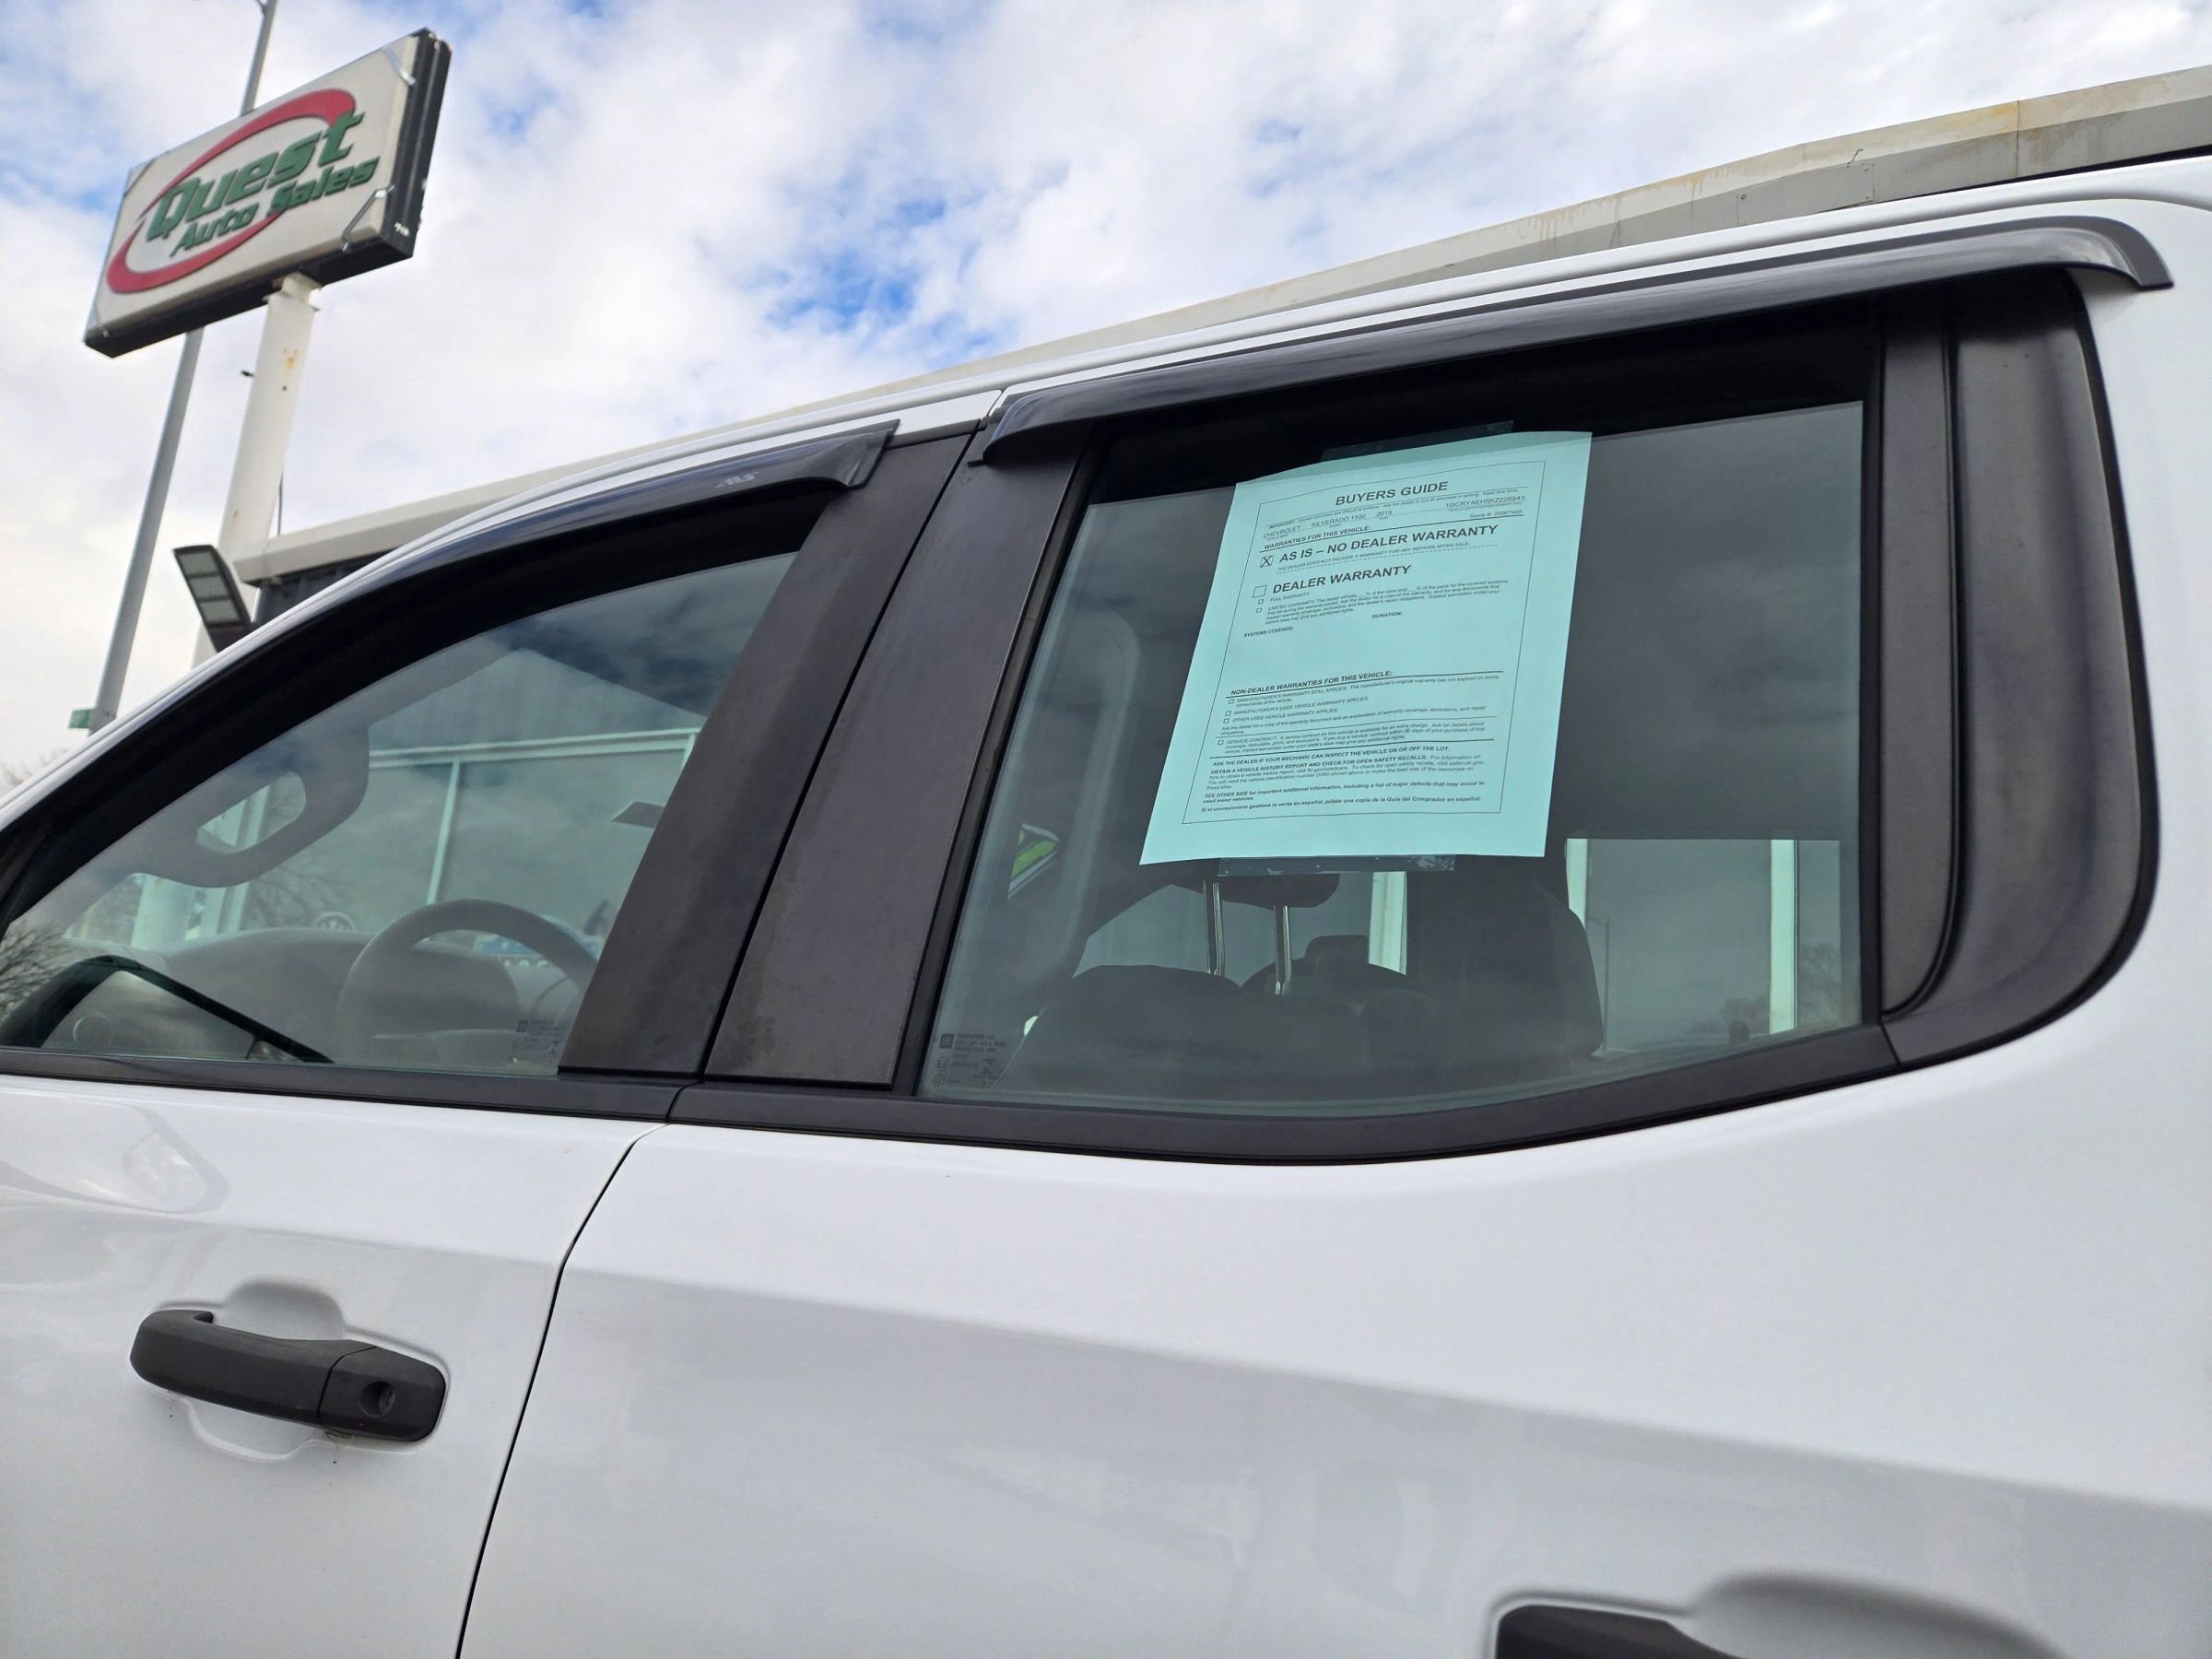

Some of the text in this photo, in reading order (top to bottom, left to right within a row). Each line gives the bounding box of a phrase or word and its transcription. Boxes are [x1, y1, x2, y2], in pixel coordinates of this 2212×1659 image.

[146, 112, 365, 242] Quest
[170, 156, 381, 257] Auto Sales
[1335, 488, 1396, 506] BUYERS
[1401, 480, 1449, 496] GUIDE
[1263, 526, 1300, 538] CHEVROLET
[1311, 517, 1349, 528] SILVERADO
[1264, 536, 1306, 550] WARRANTIES
[1340, 525, 1371, 535] VEHICLE:
[1279, 551, 1297, 563] AS
[1300, 548, 1312, 559] IS
[1327, 542, 1347, 554] NO
[1351, 535, 1407, 549] DEALER
[1412, 524, 1499, 542] WARRANTY
[1273, 564, 1411, 594] DEALER WARRANTY
[1231, 685, 1275, 695] NON-DEALER
[1277, 679, 1322, 690] WARRANTIES
[1359, 671, 1393, 680] VEHICLE:
